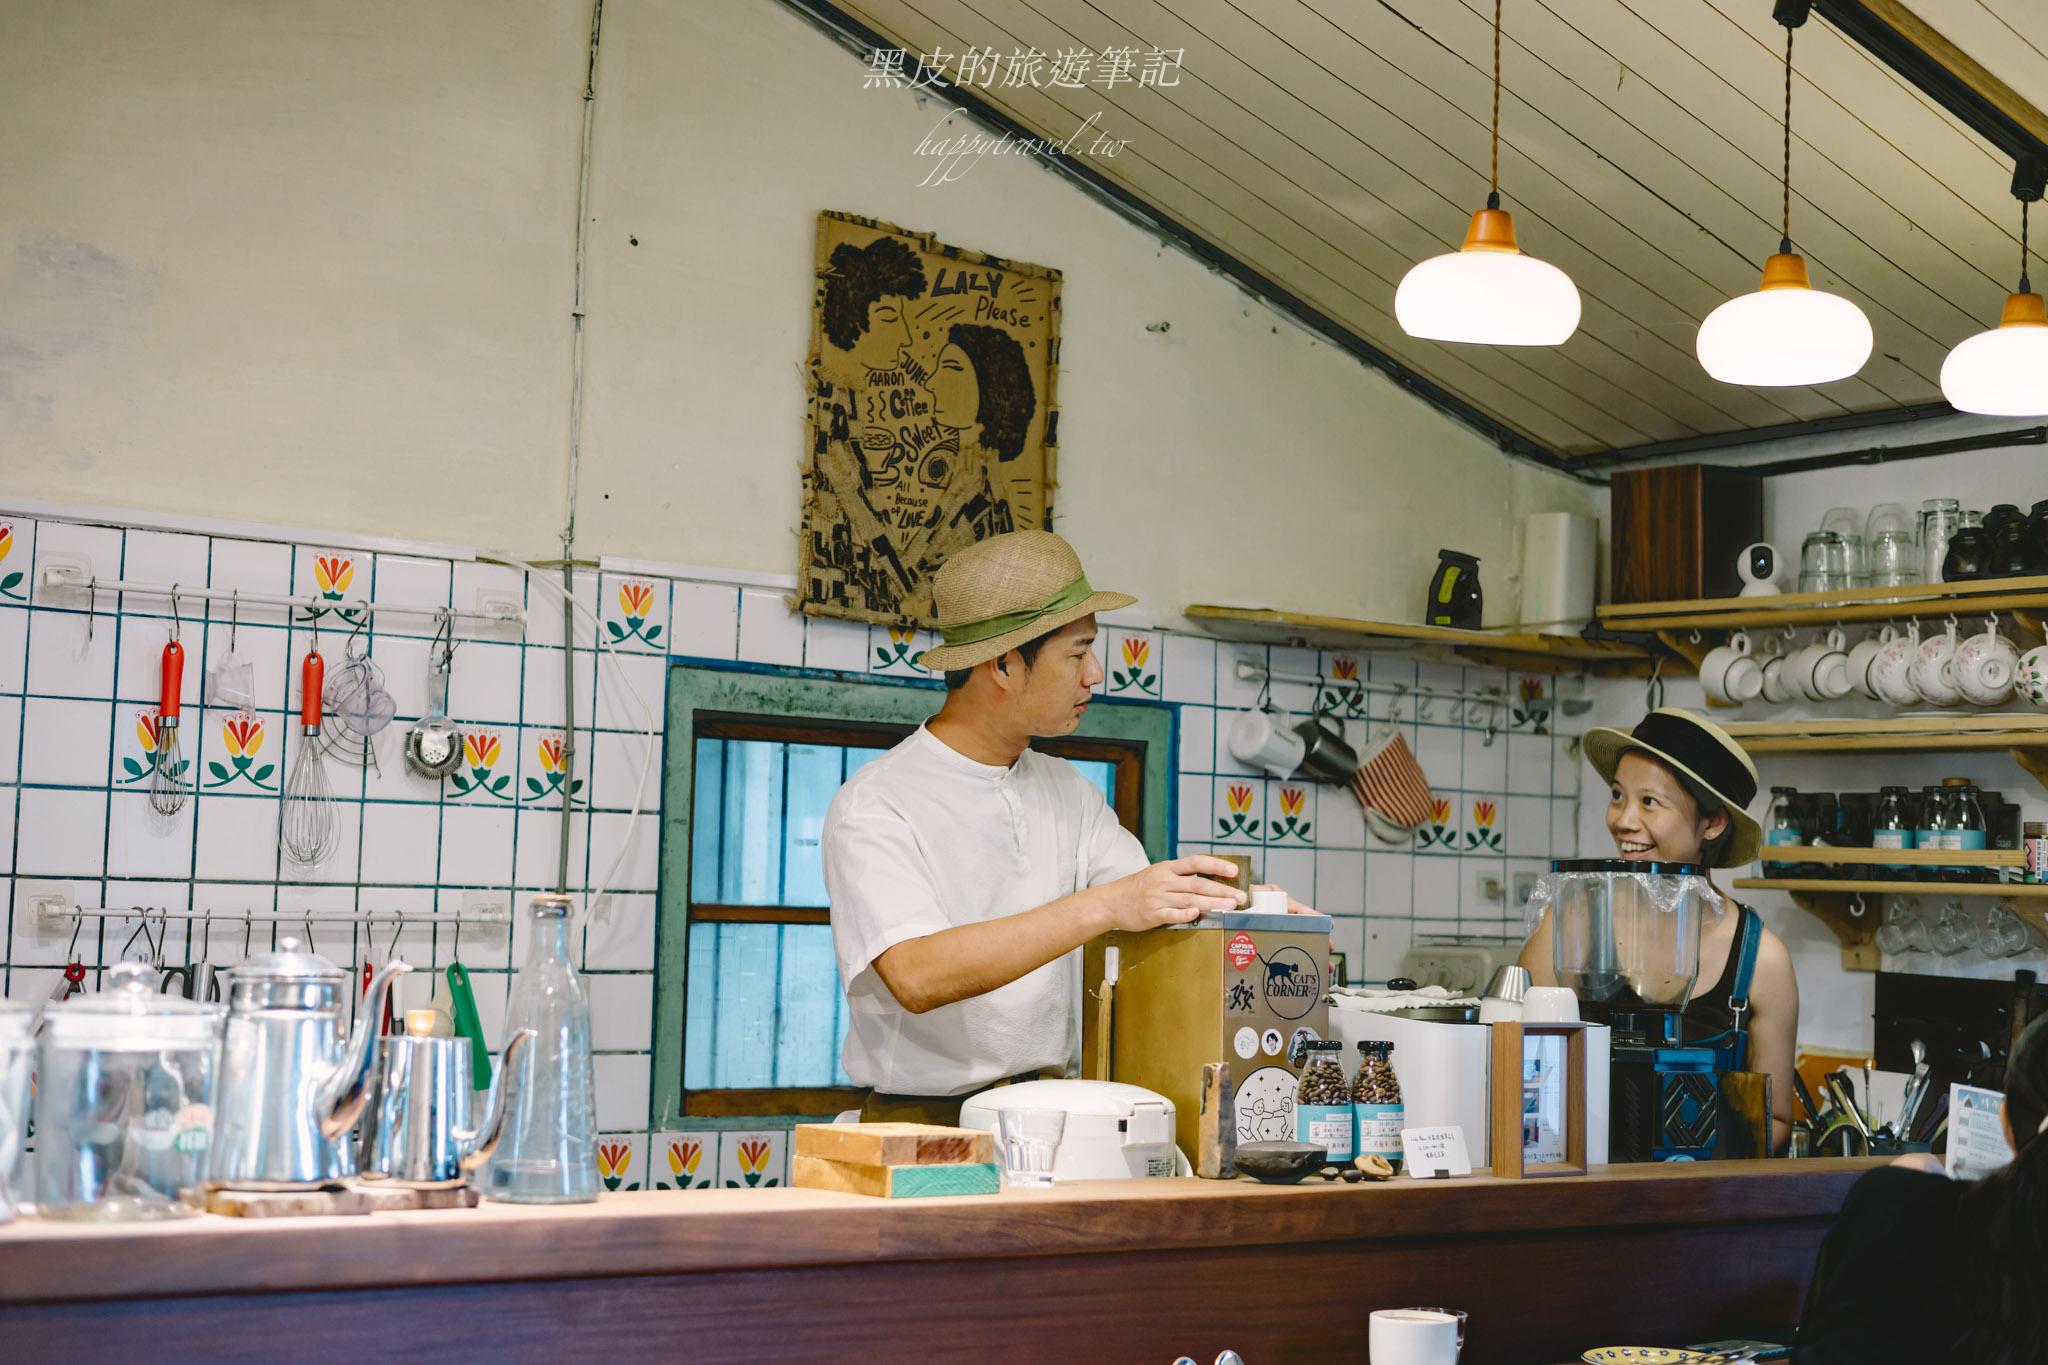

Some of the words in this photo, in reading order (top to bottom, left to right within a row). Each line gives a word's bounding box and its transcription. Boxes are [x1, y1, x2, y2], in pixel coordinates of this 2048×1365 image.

[930, 268, 1003, 297] LAZY
[895, 493, 928, 507] Because
[891, 507, 901, 517] of
[898, 509, 926, 529] LOVE
[1294, 974, 1316, 984] CAT'S
[1266, 984, 1309, 997] CORNER
